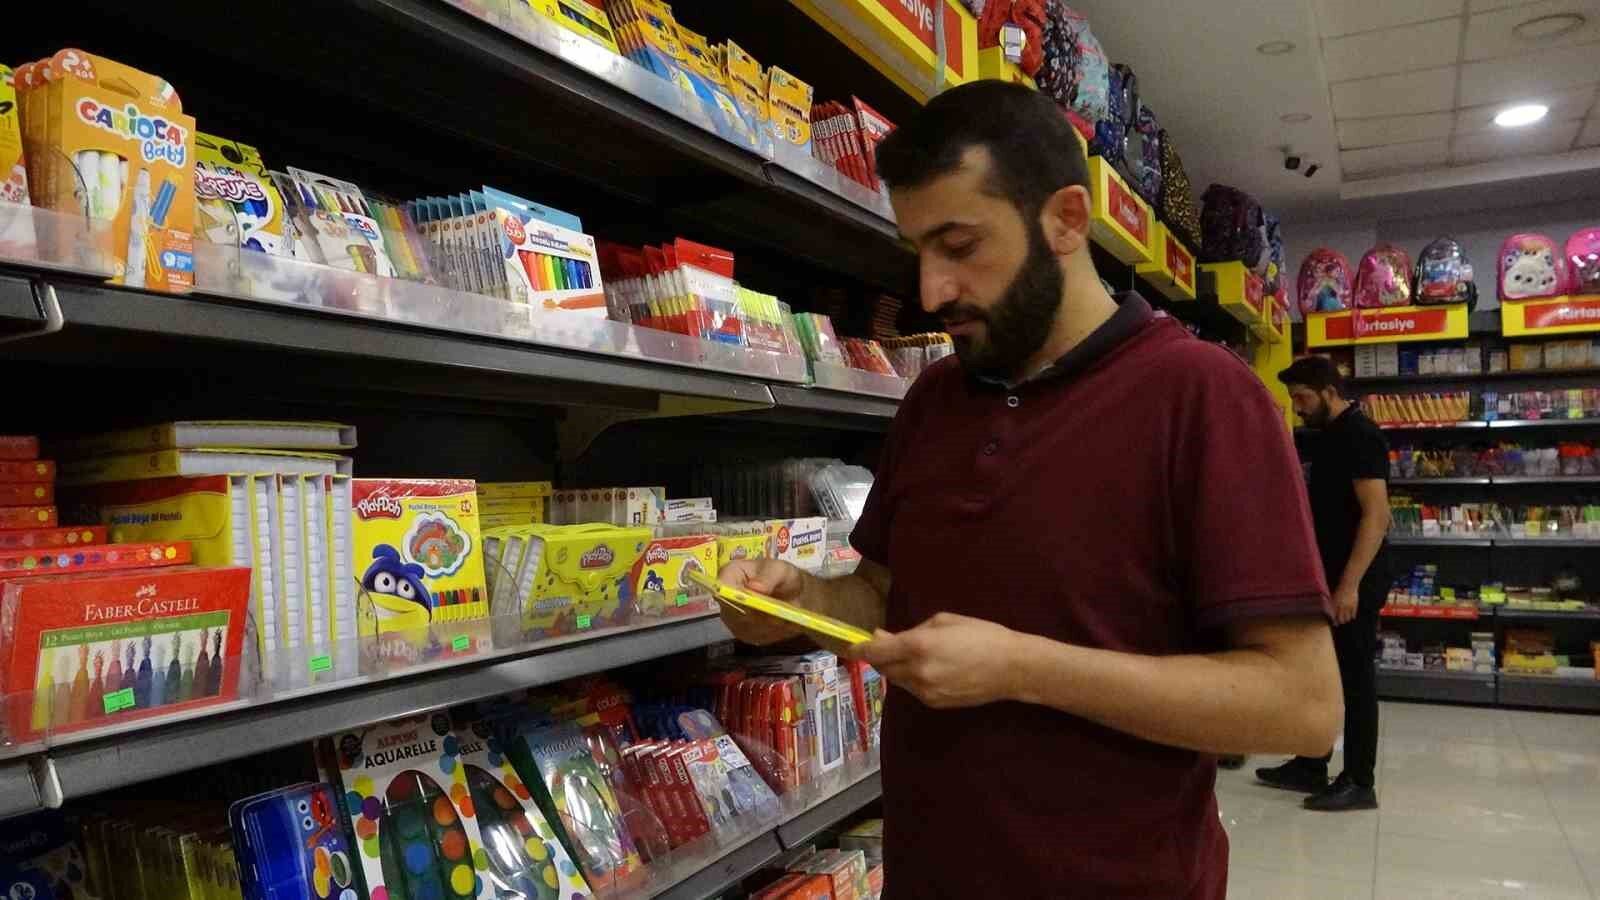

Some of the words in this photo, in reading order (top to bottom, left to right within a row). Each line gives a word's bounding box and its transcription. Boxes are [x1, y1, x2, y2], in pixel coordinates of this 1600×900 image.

[143, 140, 185, 166] Baby
[358, 494, 402, 518] Play-Doh
[84, 597, 201, 622] FABER-CASTELL
[364, 739, 438, 769] AQUARELLE
